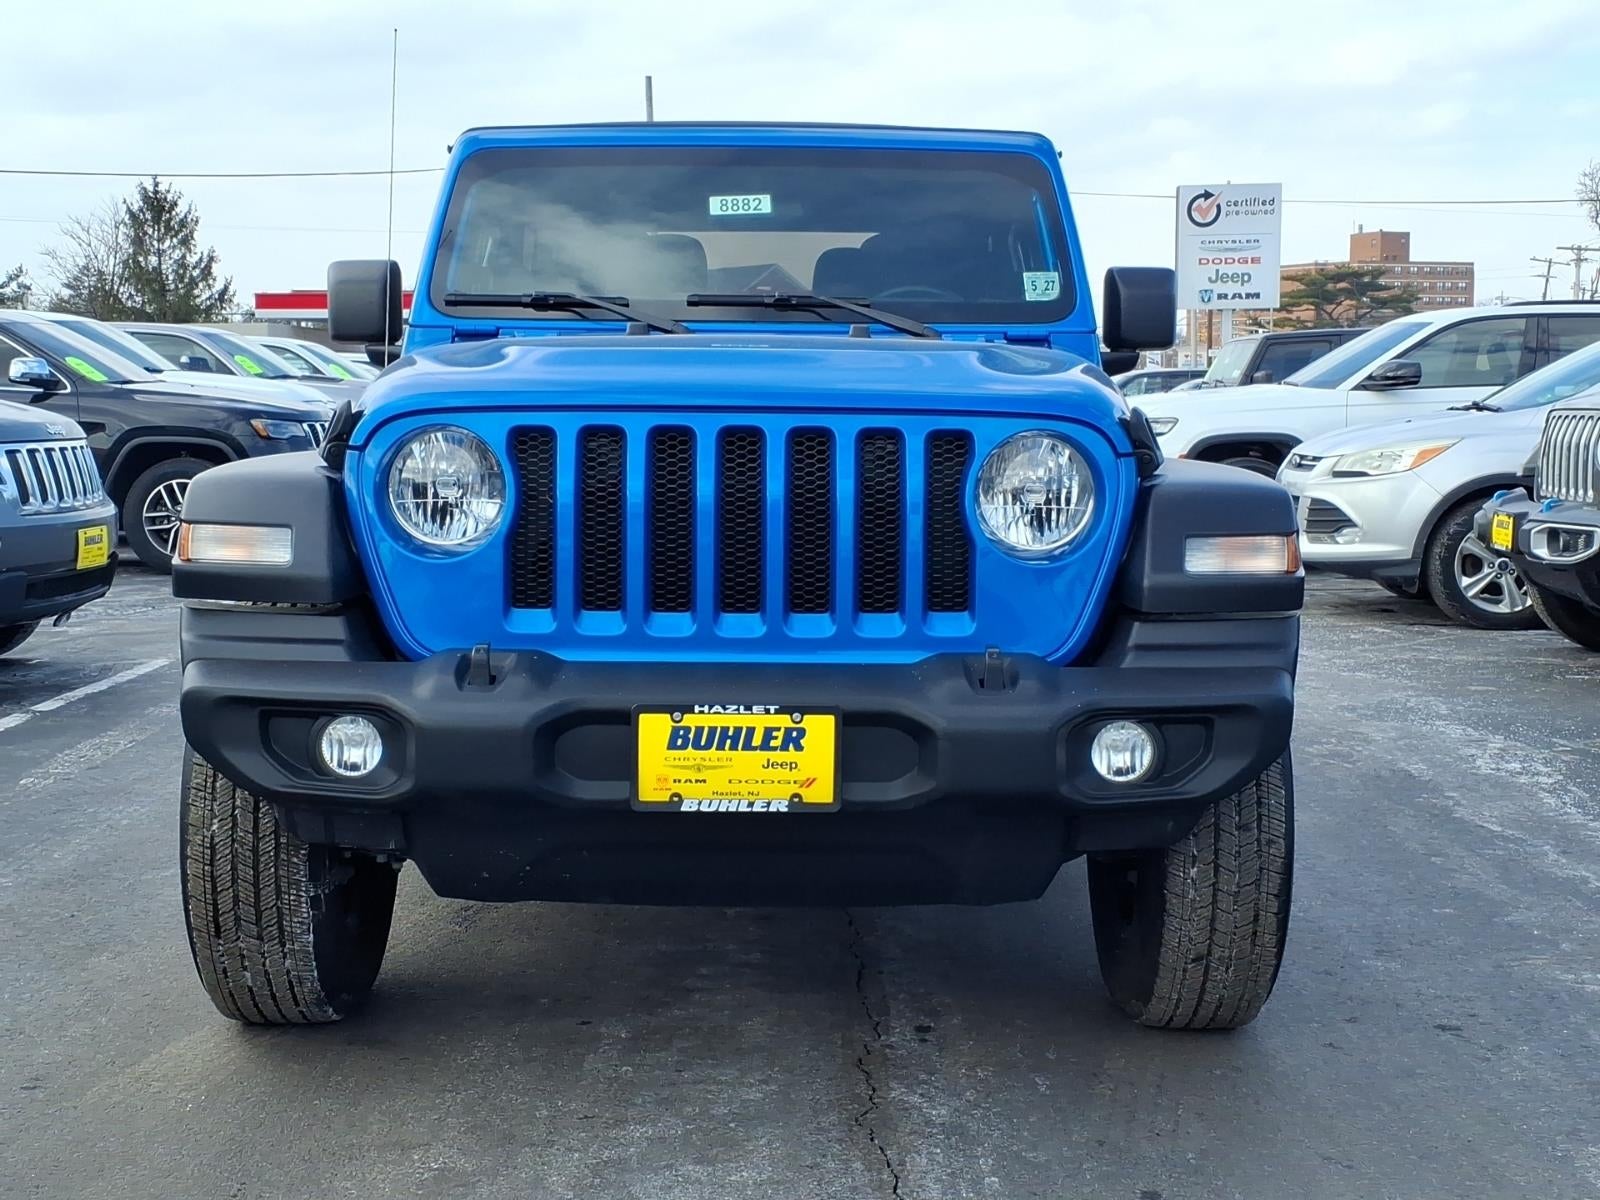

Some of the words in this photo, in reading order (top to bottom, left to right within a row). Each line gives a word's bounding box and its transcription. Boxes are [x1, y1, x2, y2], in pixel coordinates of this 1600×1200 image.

[719, 197, 762, 212] 8882
[1225, 197, 1275, 208] certified
[1225, 208, 1275, 218] pre-owned
[1198, 257, 1261, 265] DODGE
[1208, 268, 1252, 286] Jeep
[1031, 280, 1038, 292] 5
[1044, 280, 1056, 292] 27
[1216, 292, 1261, 301] RAM
[694, 704, 780, 714] HAZLET
[666, 725, 807, 752] BUHLER
[761, 758, 799, 772] Jeep
[711, 790, 744, 798] Hazlet,
[680, 798, 790, 813] BUHLER
